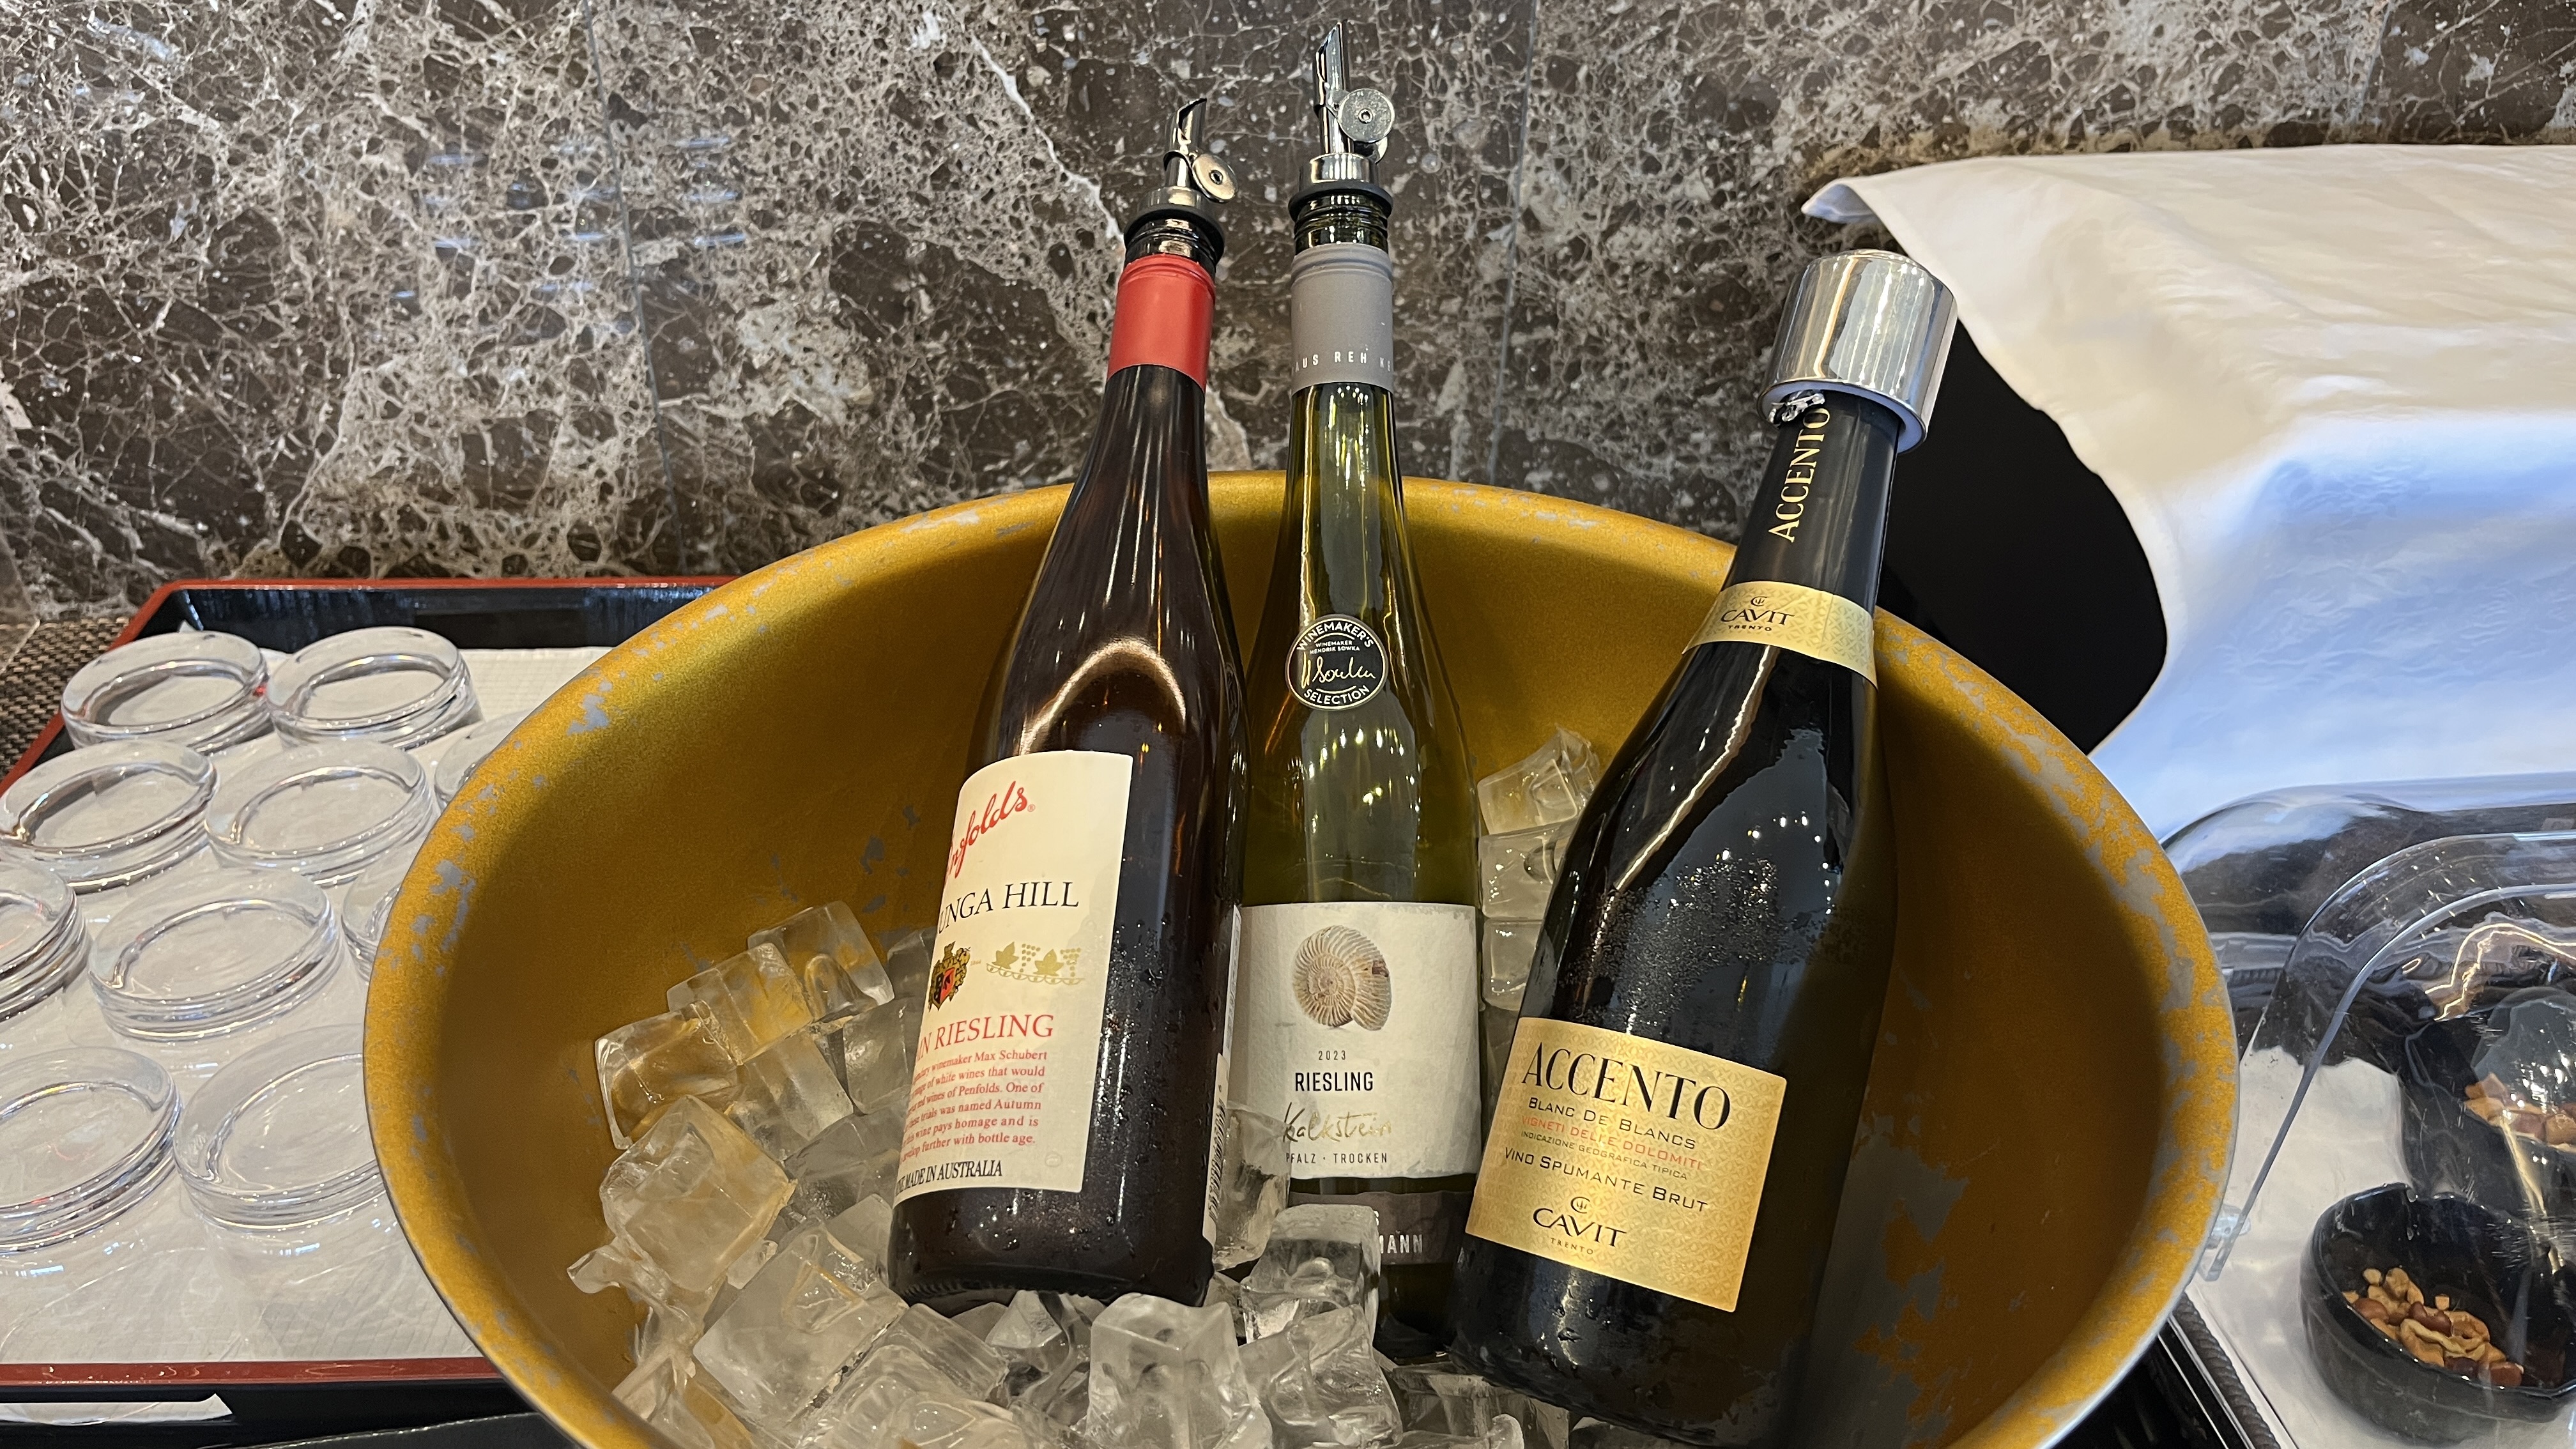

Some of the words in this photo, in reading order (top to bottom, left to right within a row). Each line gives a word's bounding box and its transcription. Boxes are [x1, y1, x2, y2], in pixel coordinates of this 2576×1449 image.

[1334, 351, 1367, 364] REH
[1768, 408, 1831, 543] ACCENTO
[1721, 608, 1795, 625] CAVIT
[1297, 621, 1374, 651] WINEMAKER'S
[1310, 647, 1337, 655] HENDRIK
[1303, 684, 1370, 705] SELECTION
[1001, 881, 1080, 910] HILL
[933, 1014, 1054, 1050] RIESLING
[931, 1054, 972, 1071] winemaker
[974, 1051, 996, 1062] Max
[999, 1049, 1047, 1060] Schubert
[1318, 1050, 1347, 1061] 2023
[935, 1073, 956, 1085] white
[958, 1068, 985, 1080] wines
[988, 1066, 1008, 1077] that
[1011, 1065, 1045, 1077] would
[1294, 1071, 1374, 1091] RIESLING
[1521, 1041, 1731, 1130] ACCENTO
[947, 1086, 958, 1098] of
[1006, 1082, 1028, 1092] One
[1031, 1082, 1045, 1093] of
[939, 1106, 956, 1115] was
[958, 1099, 992, 1112] named
[993, 1098, 1041, 1110] Autumn
[932, 1122, 953, 1137] pays
[954, 1118, 998, 1130] homage
[1000, 1116, 1024, 1126] and
[1029, 1116, 1039, 1126] is
[1282, 1101, 1392, 1143] Kalkstein
[922, 1137, 951, 1153] further
[953, 1133, 975, 1146] with
[977, 1132, 1009, 1144] bottle
[1011, 1135, 1036, 1146] age.
[1522, 1115, 1565, 1133] VIGNETI
[1570, 1126, 1618, 1147] DELLE
[1622, 1140, 1703, 1170] DOLOMITI
[1285, 1153, 1317, 1164] PFALZ
[1333, 1153, 1388, 1164] TROCKEN
[1521, 1130, 1575, 1149] INDICAZIONE
[1578, 1144, 1648, 1169] GEOGRAFICA
[1652, 1163, 1688, 1181] TIPICA
[925, 1165, 937, 1183] IN
[936, 1160, 1002, 1181] AUSTRALIA
[1533, 1208, 1627, 1247] CAVIT
[1550, 1237, 1594, 1255] TRENTO
